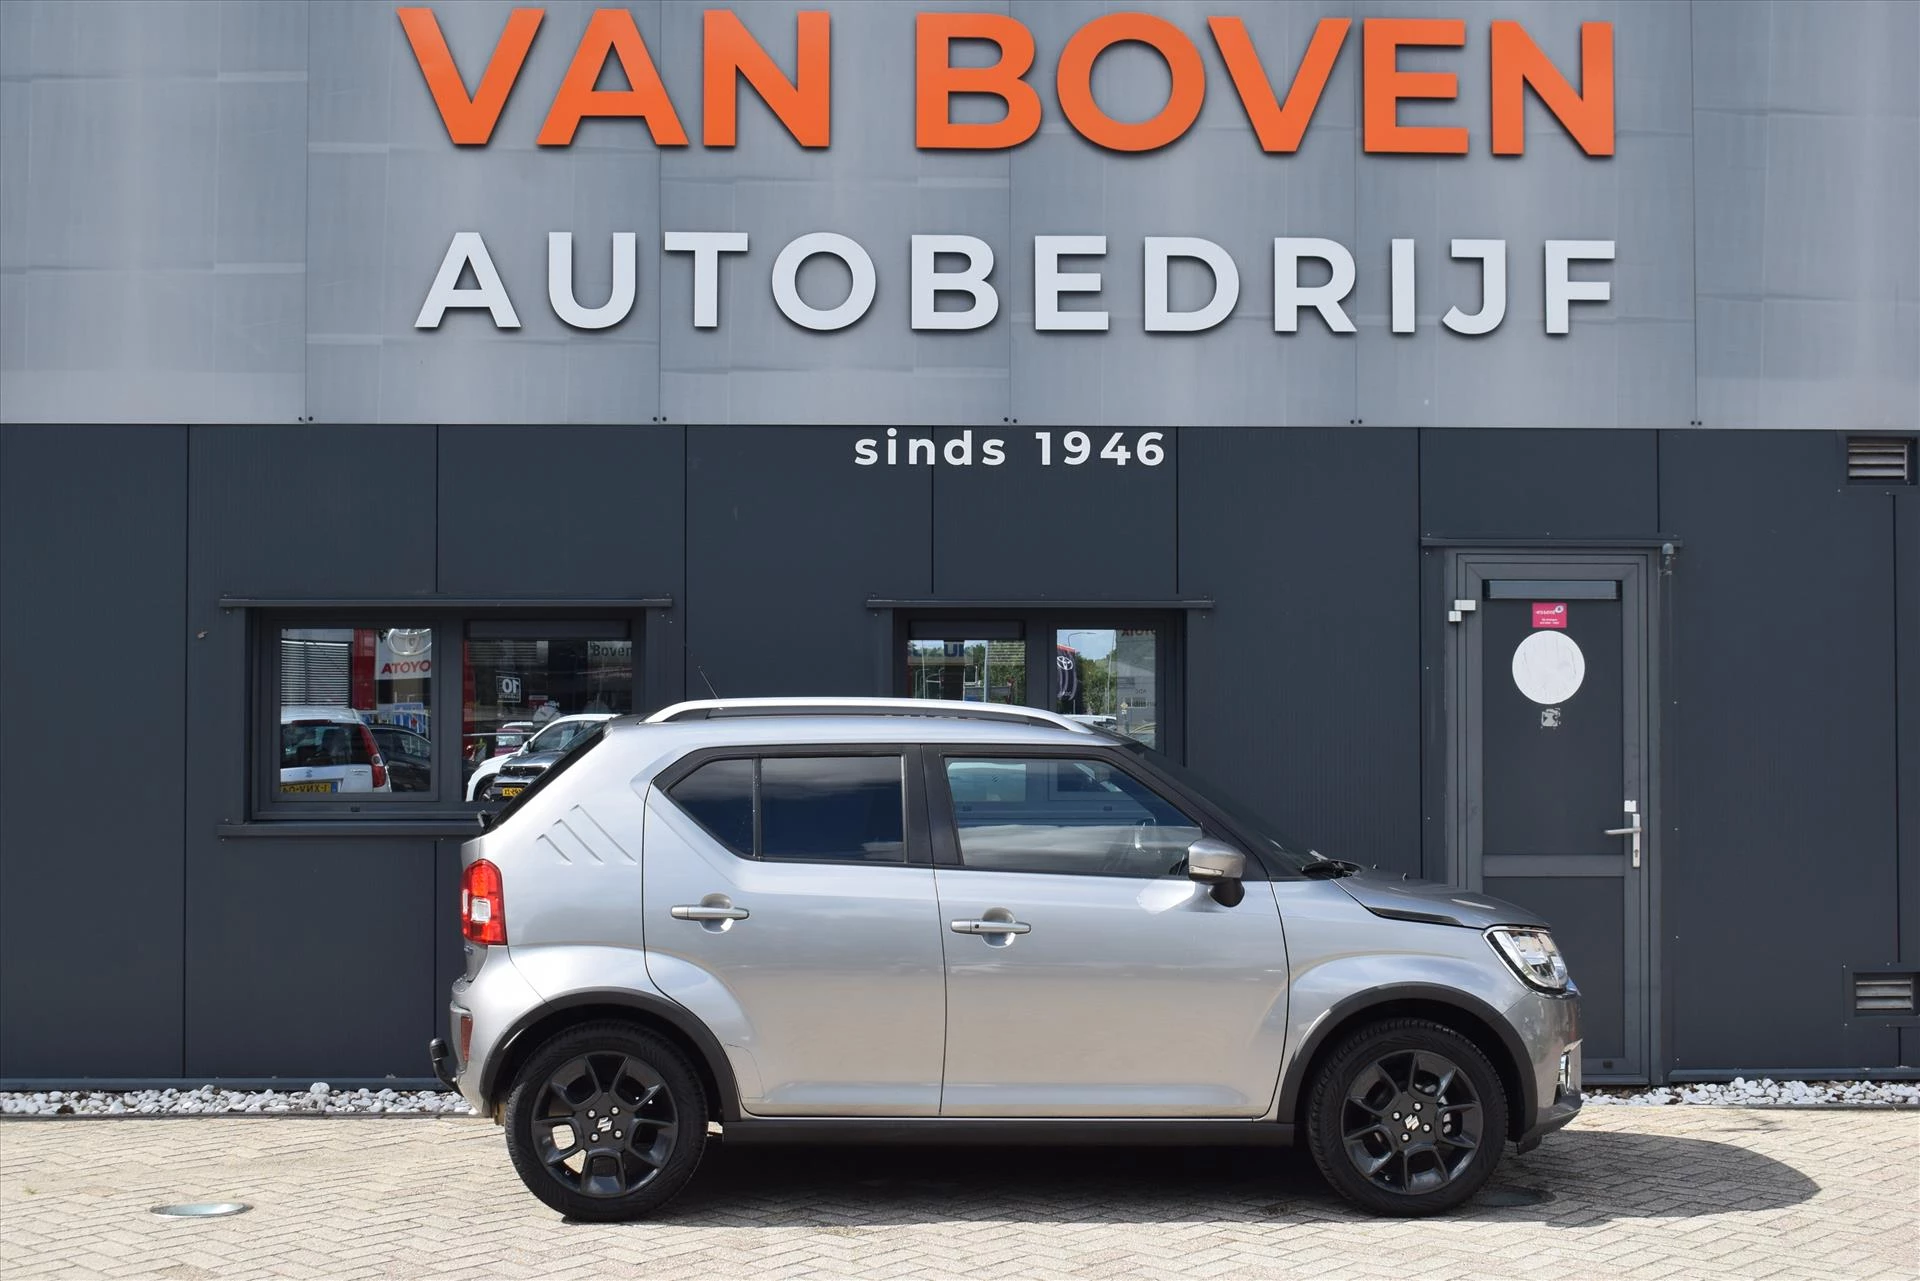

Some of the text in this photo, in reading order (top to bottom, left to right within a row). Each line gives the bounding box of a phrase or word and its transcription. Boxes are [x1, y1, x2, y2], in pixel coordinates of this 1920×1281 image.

[399, 8, 1613, 154] VAN BOVEN
[414, 231, 1617, 335] AUTOBEDRIJF
[854, 430, 1165, 466] sinds 1946
